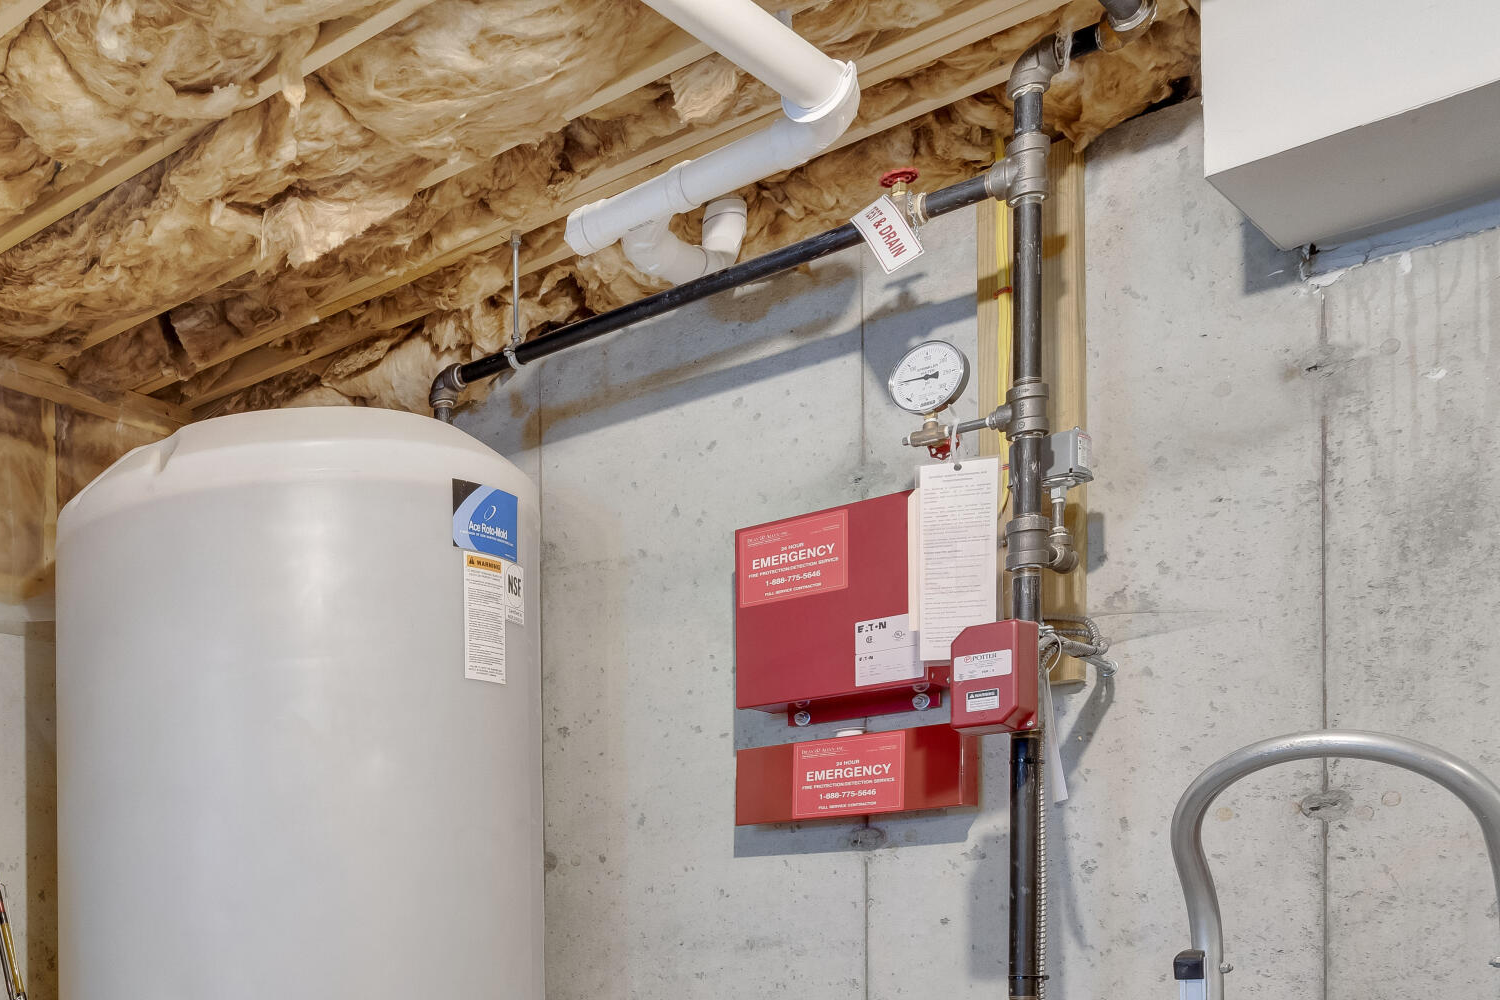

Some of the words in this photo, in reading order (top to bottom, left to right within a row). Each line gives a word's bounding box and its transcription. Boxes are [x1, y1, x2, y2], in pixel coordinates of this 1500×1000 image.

[873, 217, 887, 229] &
[879, 225, 907, 257] DRAIN
[468, 520, 481, 532] Ace
[482, 523, 508, 540] Roto-Mold
[752, 543, 835, 570] EMERGENCY
[818, 557, 839, 565] SERVICE
[476, 560, 501, 571] WARNING
[973, 653, 997, 661] POTTER
[806, 763, 892, 782] EMERGENCY
